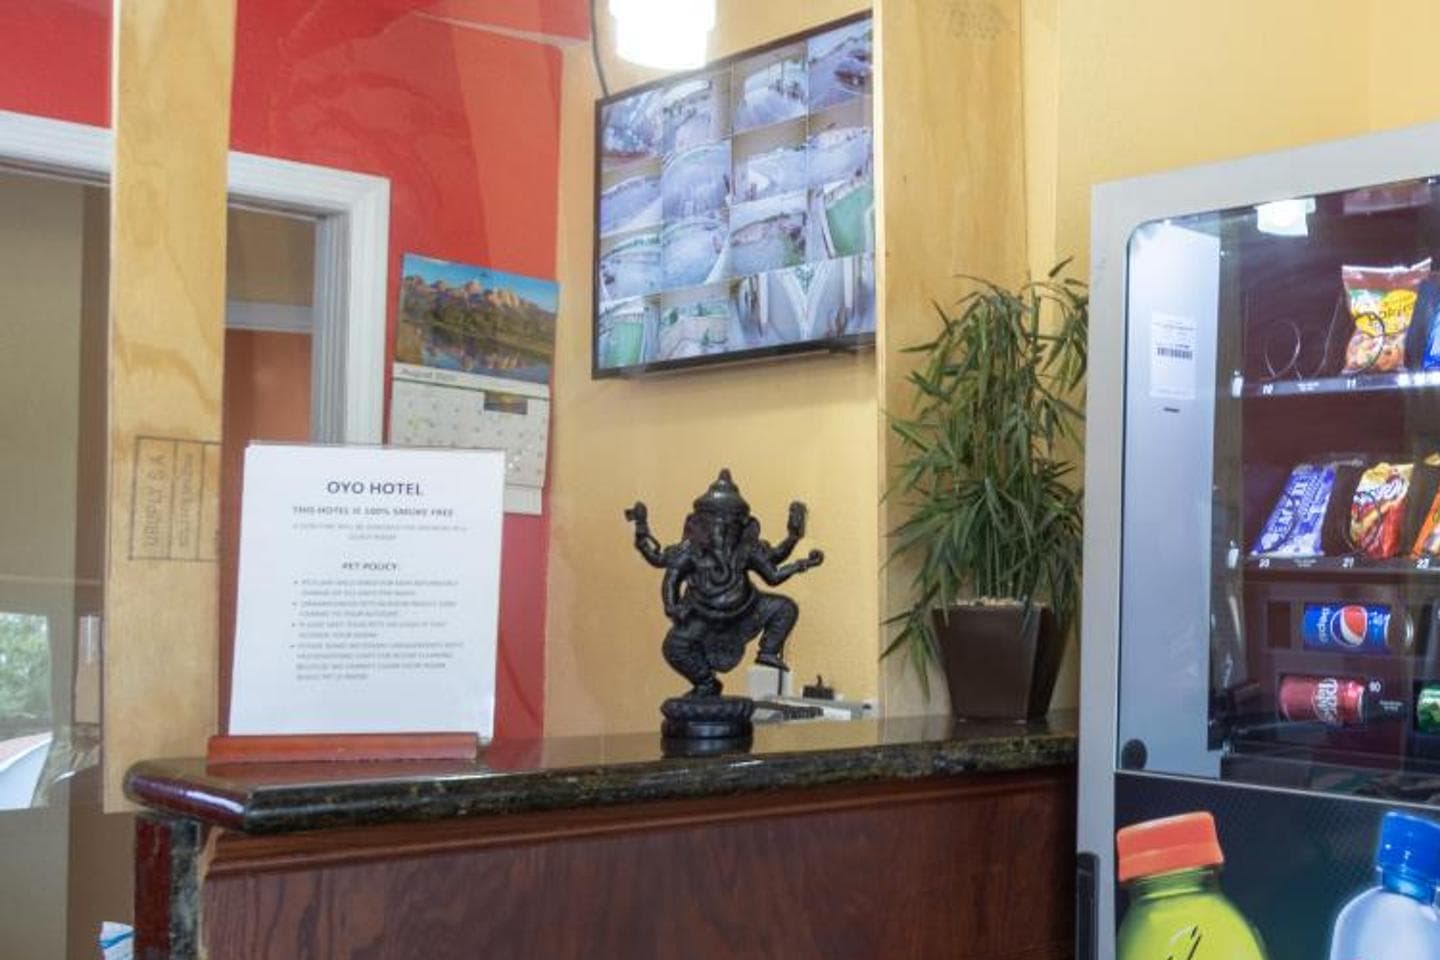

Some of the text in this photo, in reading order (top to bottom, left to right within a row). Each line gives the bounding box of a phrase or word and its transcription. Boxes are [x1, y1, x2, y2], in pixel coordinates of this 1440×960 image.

[327, 481, 423, 496] OYO HOTEL
[342, 562, 398, 572] PET POLICY
